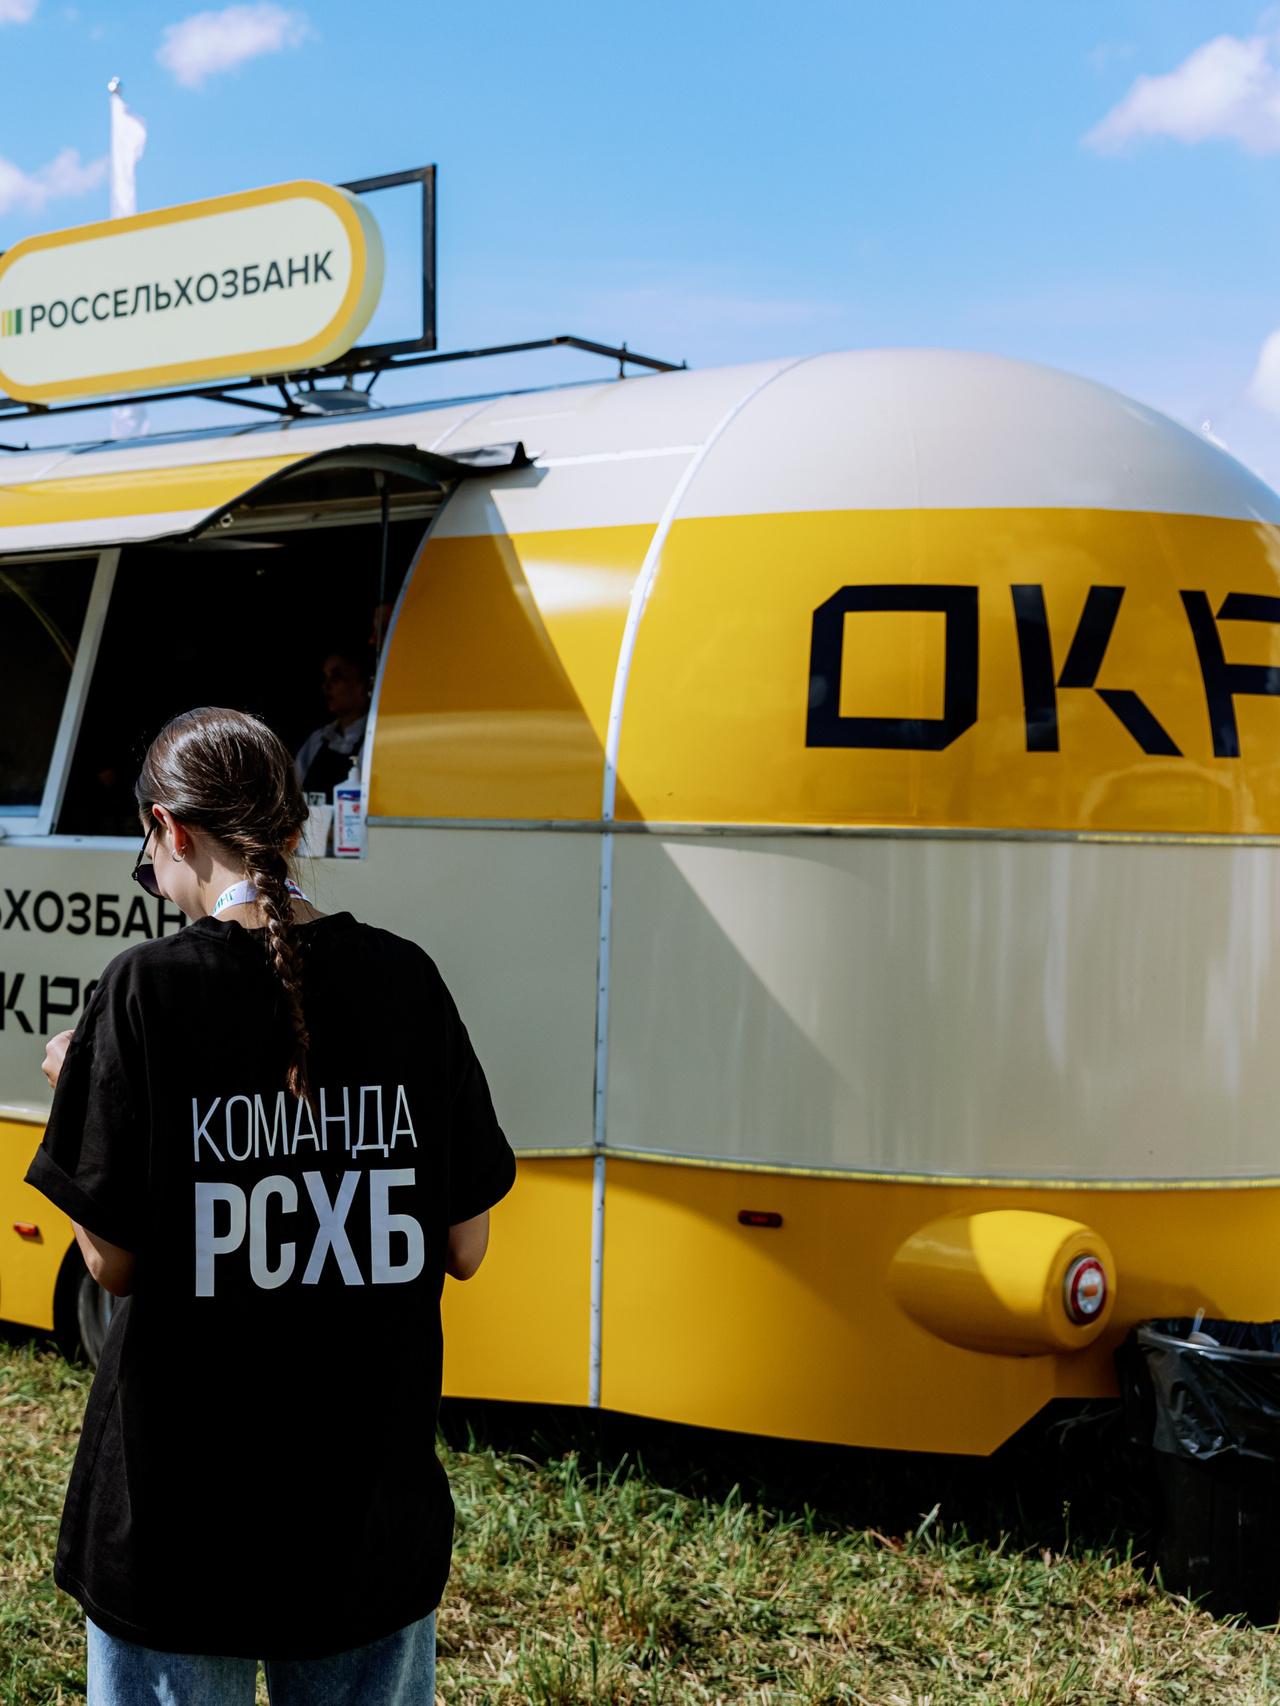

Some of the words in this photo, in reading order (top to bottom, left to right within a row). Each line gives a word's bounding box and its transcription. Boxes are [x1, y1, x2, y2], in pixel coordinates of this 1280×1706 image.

[30, 250, 334, 333] РОССЕЛЬХОЗБАНК
[192, 1084, 418, 1162] КОМАНДА
[195, 1167, 425, 1297] РСХБ
